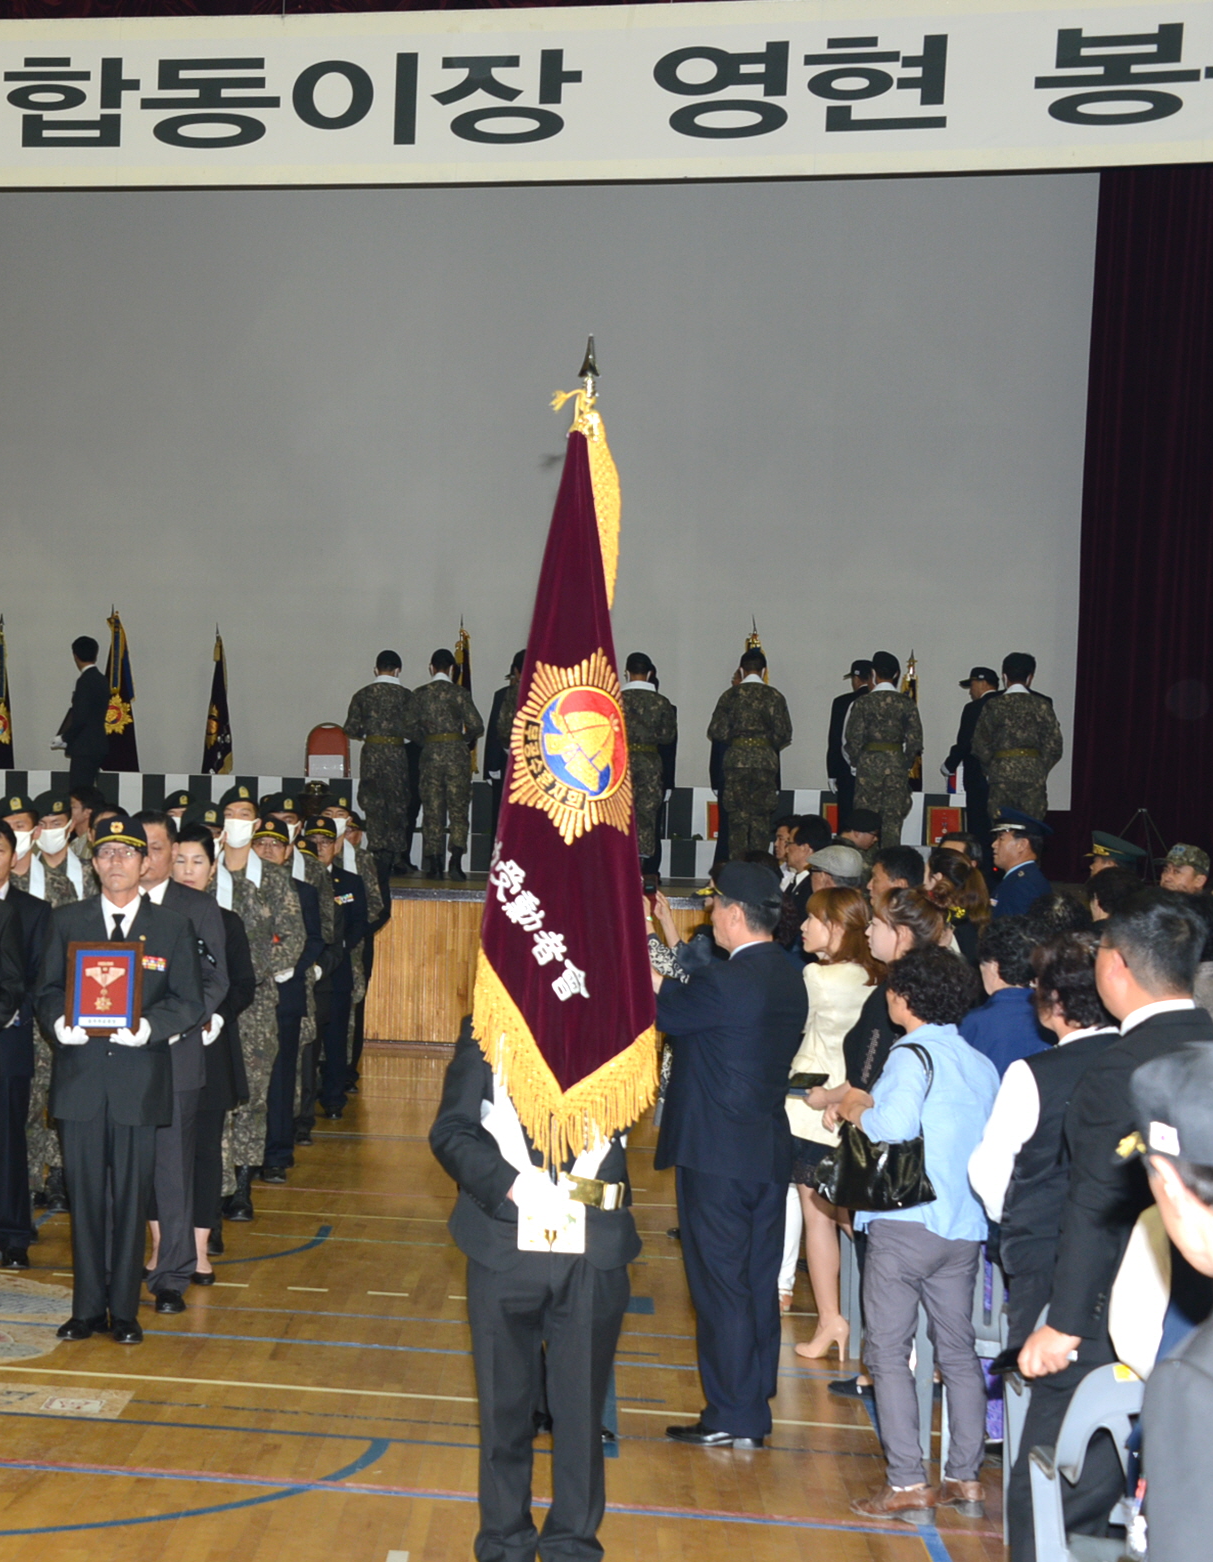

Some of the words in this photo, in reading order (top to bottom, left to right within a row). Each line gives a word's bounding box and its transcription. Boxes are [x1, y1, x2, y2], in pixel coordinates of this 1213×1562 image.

[3, 49, 583, 150] 합동이장
[653, 34, 948, 139] 영현
[1034, 23, 1213, 126] 봉
[524, 721, 586, 809] 무공수훈자회
